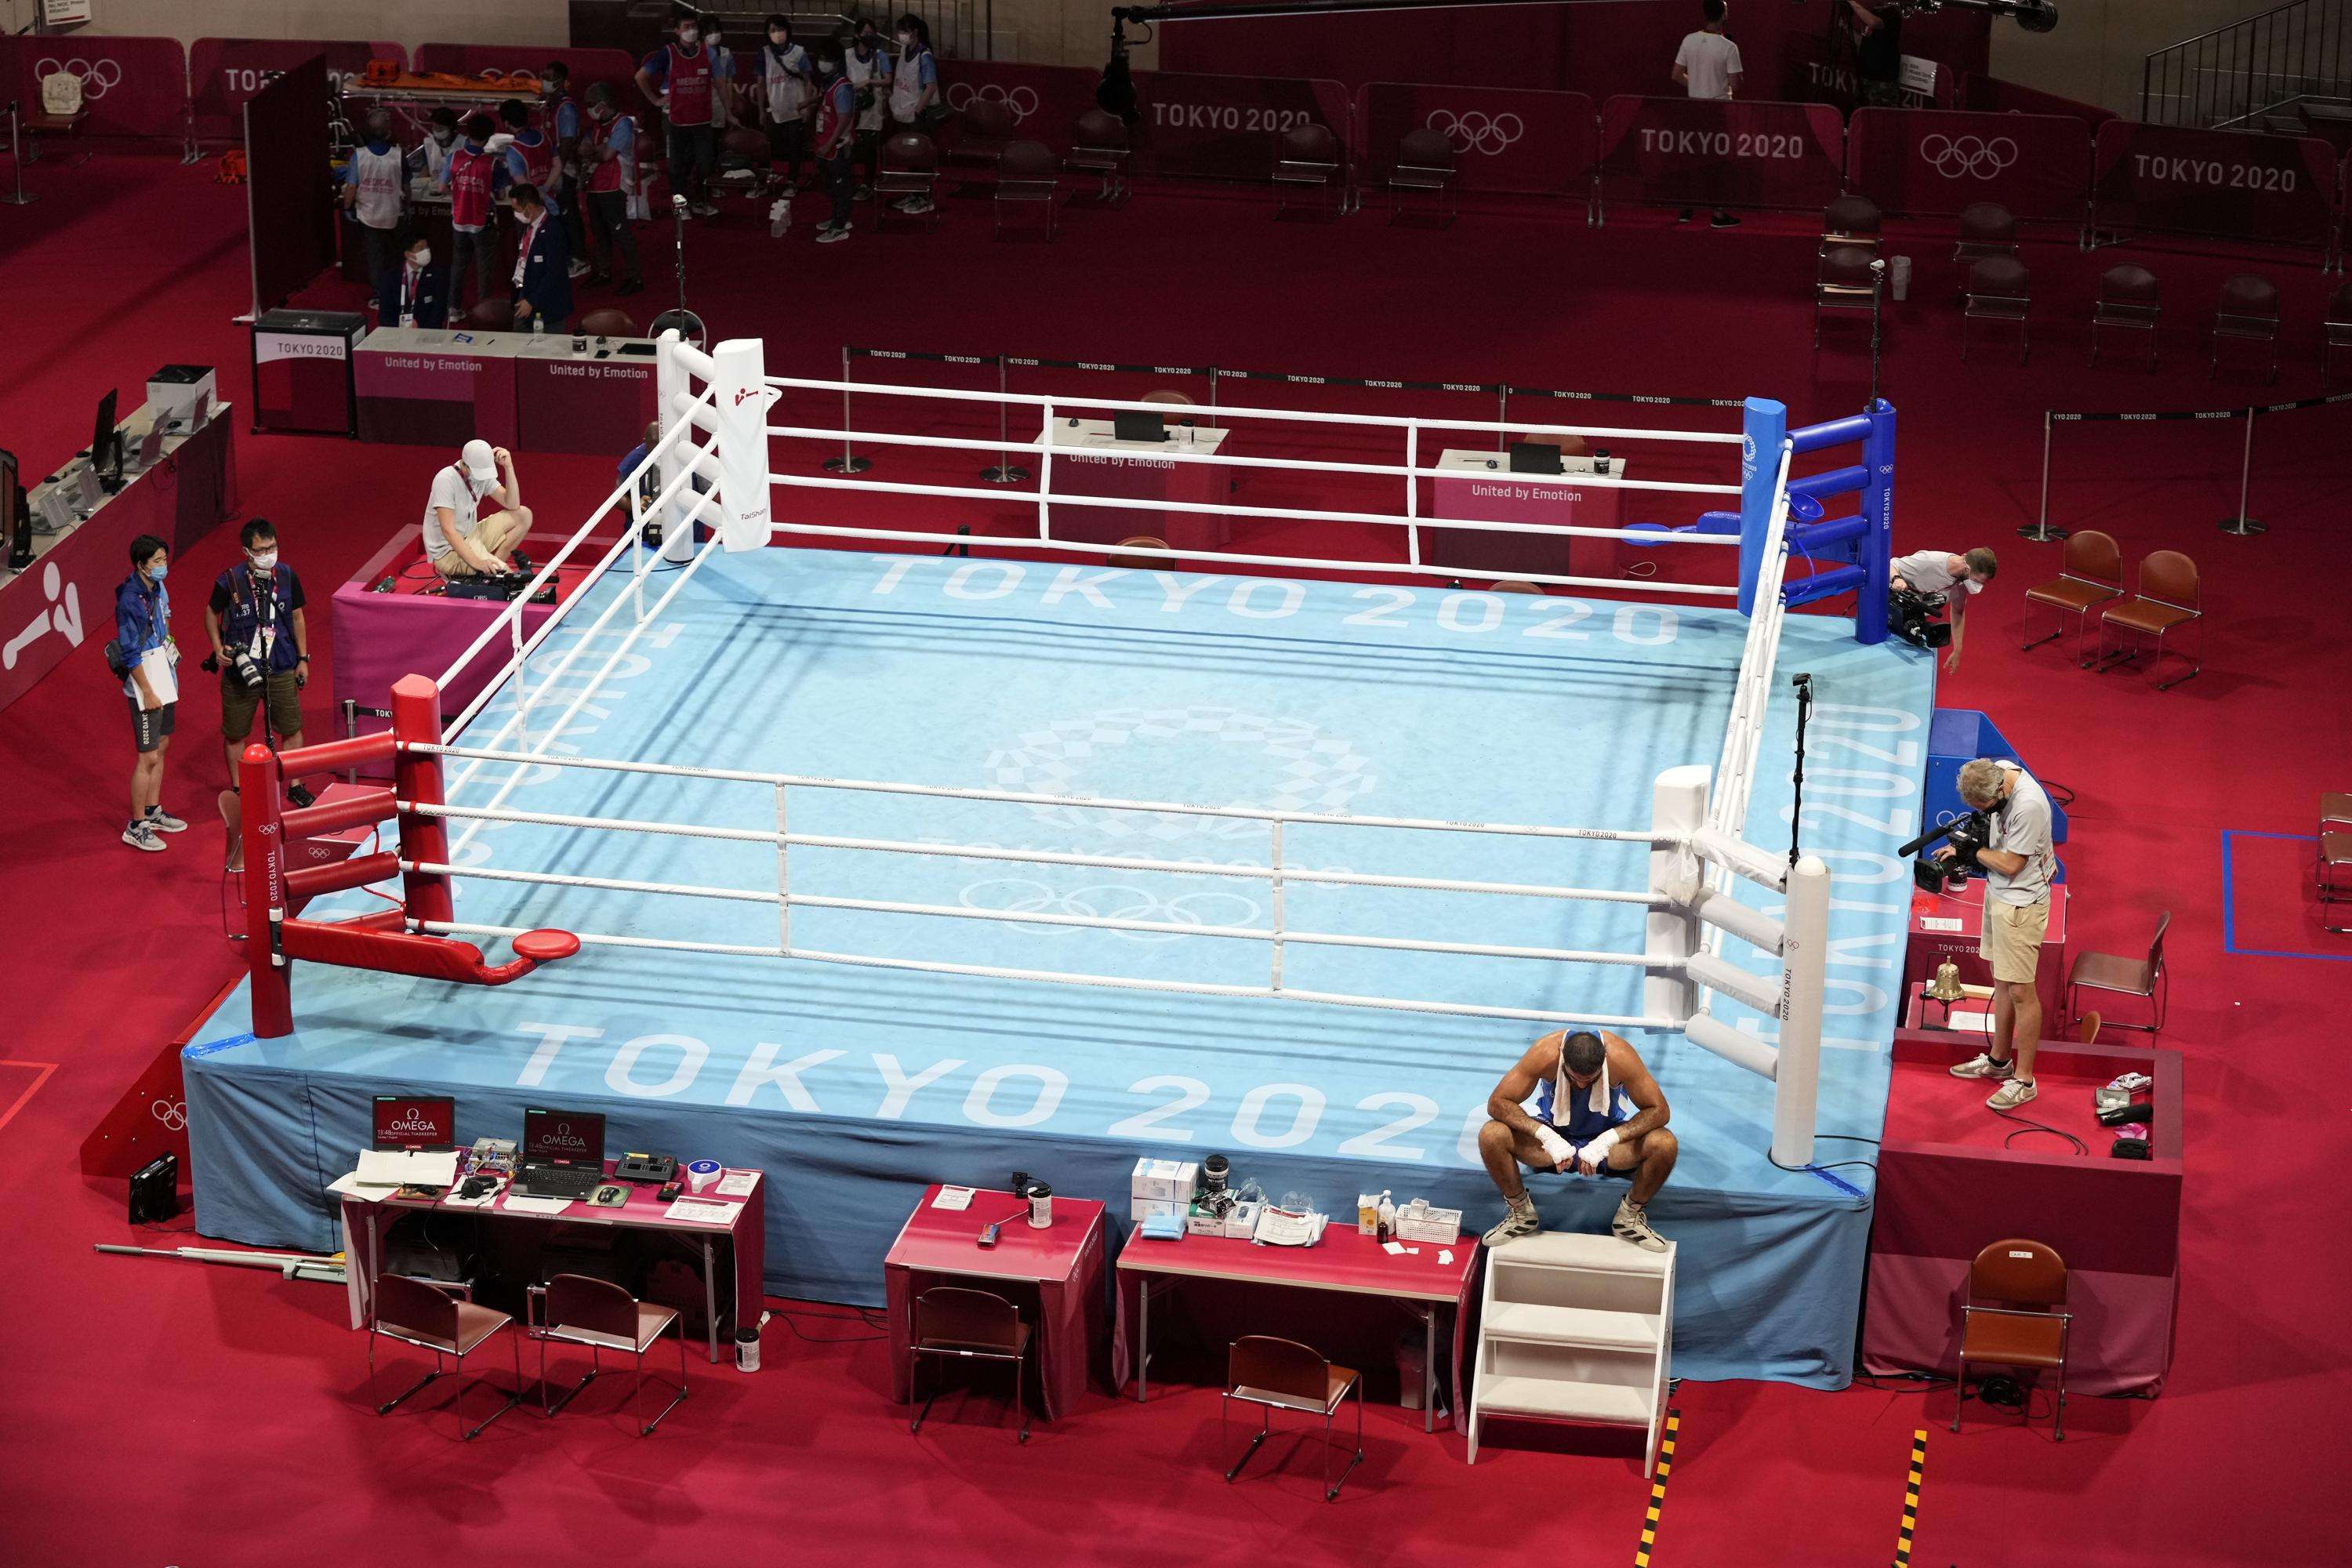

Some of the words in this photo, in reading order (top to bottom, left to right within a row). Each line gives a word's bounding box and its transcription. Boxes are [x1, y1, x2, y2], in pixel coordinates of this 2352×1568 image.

[1808, 61, 1857, 93] TOKY
[1152, 103, 1239, 130] TOKYO
[1246, 108, 1310, 132] 2020
[1641, 129, 1730, 154] TOKYO
[1737, 132, 1803, 158] 2020
[2135, 154, 2223, 184] TOKYO
[2230, 165, 2296, 193] 2020
[278, 343, 313, 354] TOKYO
[315, 345, 343, 356] 2020
[385, 357, 419, 368] United
[423, 358, 435, 370] by
[438, 361, 482, 372] Emotion
[550, 365, 585, 376] United
[589, 366, 601, 378] by
[604, 367, 648, 379] Emotion
[1070, 455, 1107, 464] United
[1112, 456, 1123, 467] by
[1128, 458, 1175, 470] Emotion
[1472, 485, 1511, 497] United
[1515, 487, 1529, 500] by
[1533, 488, 1581, 502] Emotion
[741, 508, 766, 520] TaiShan
[871, 554, 1306, 619] TOKYO
[1342, 587, 1679, 646] 2020
[1780, 703, 1921, 837] 2020
[1578, 829, 1599, 837] TOKYO
[1600, 830, 1617, 839] 2020
[267, 850, 277, 880] TOKYO
[269, 881, 278, 902] 2020
[1938, 944, 1964, 953] TOKYO
[516, 1022, 1069, 1127] TOKYO
[391, 1120, 436, 1131] OMEGA
[543, 1134, 586, 1147] OMEGA
